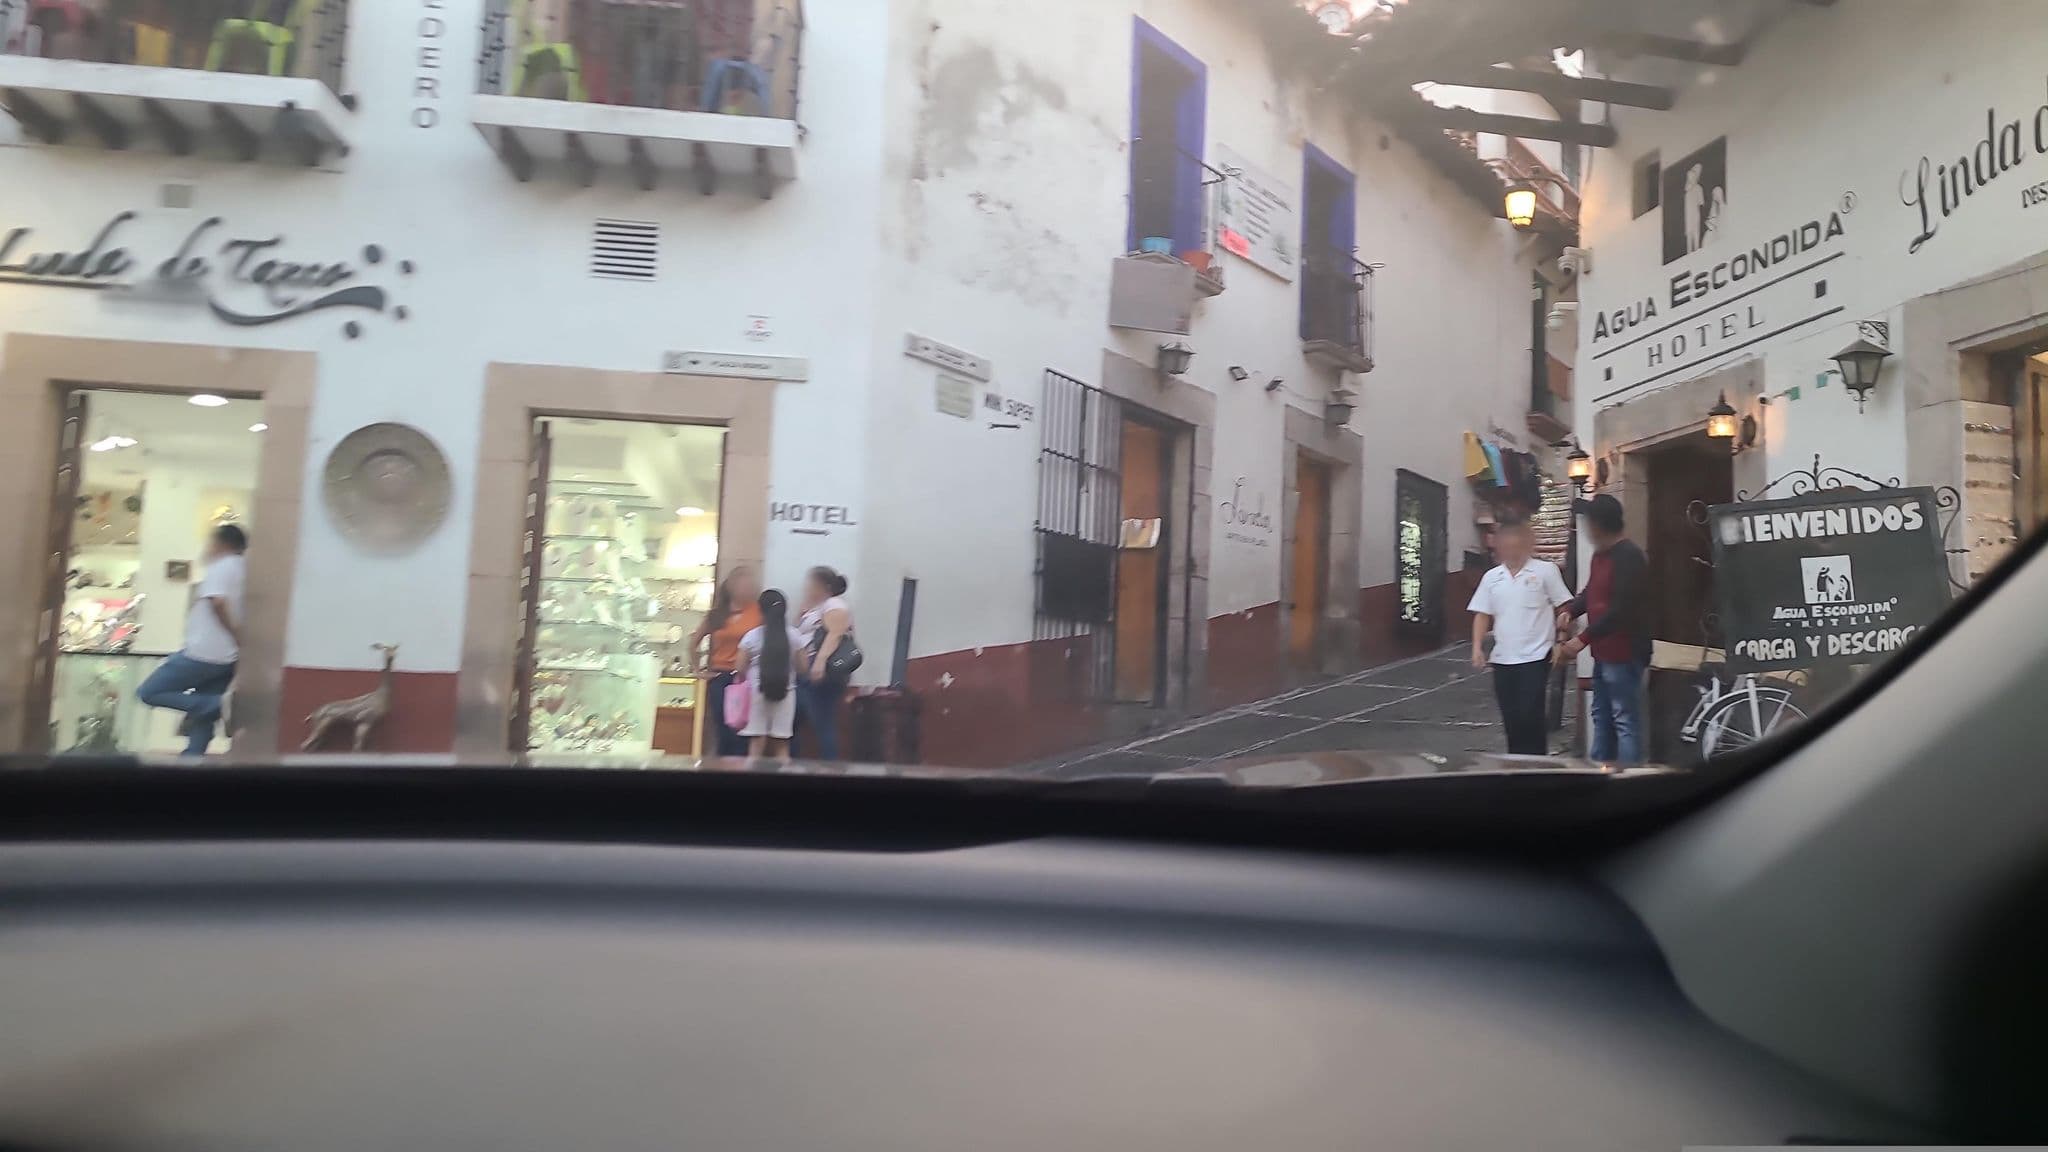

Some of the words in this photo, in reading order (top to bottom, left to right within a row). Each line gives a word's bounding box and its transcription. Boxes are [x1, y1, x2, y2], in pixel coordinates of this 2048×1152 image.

[1900, 107, 2023, 254] Linda
[156, 216, 222, 280] de
[1592, 297, 1658, 344] AGUA
[1647, 306, 1765, 367] HOTEL
[769, 502, 858, 526] HOTEL
[1772, 605, 1808, 620] AGUA
[1801, 615, 1872, 628] HOTEL
[1735, 637, 1797, 661] CARGA
[1804, 635, 1822, 658] Y
[1828, 625, 1928, 656] DESCAR
